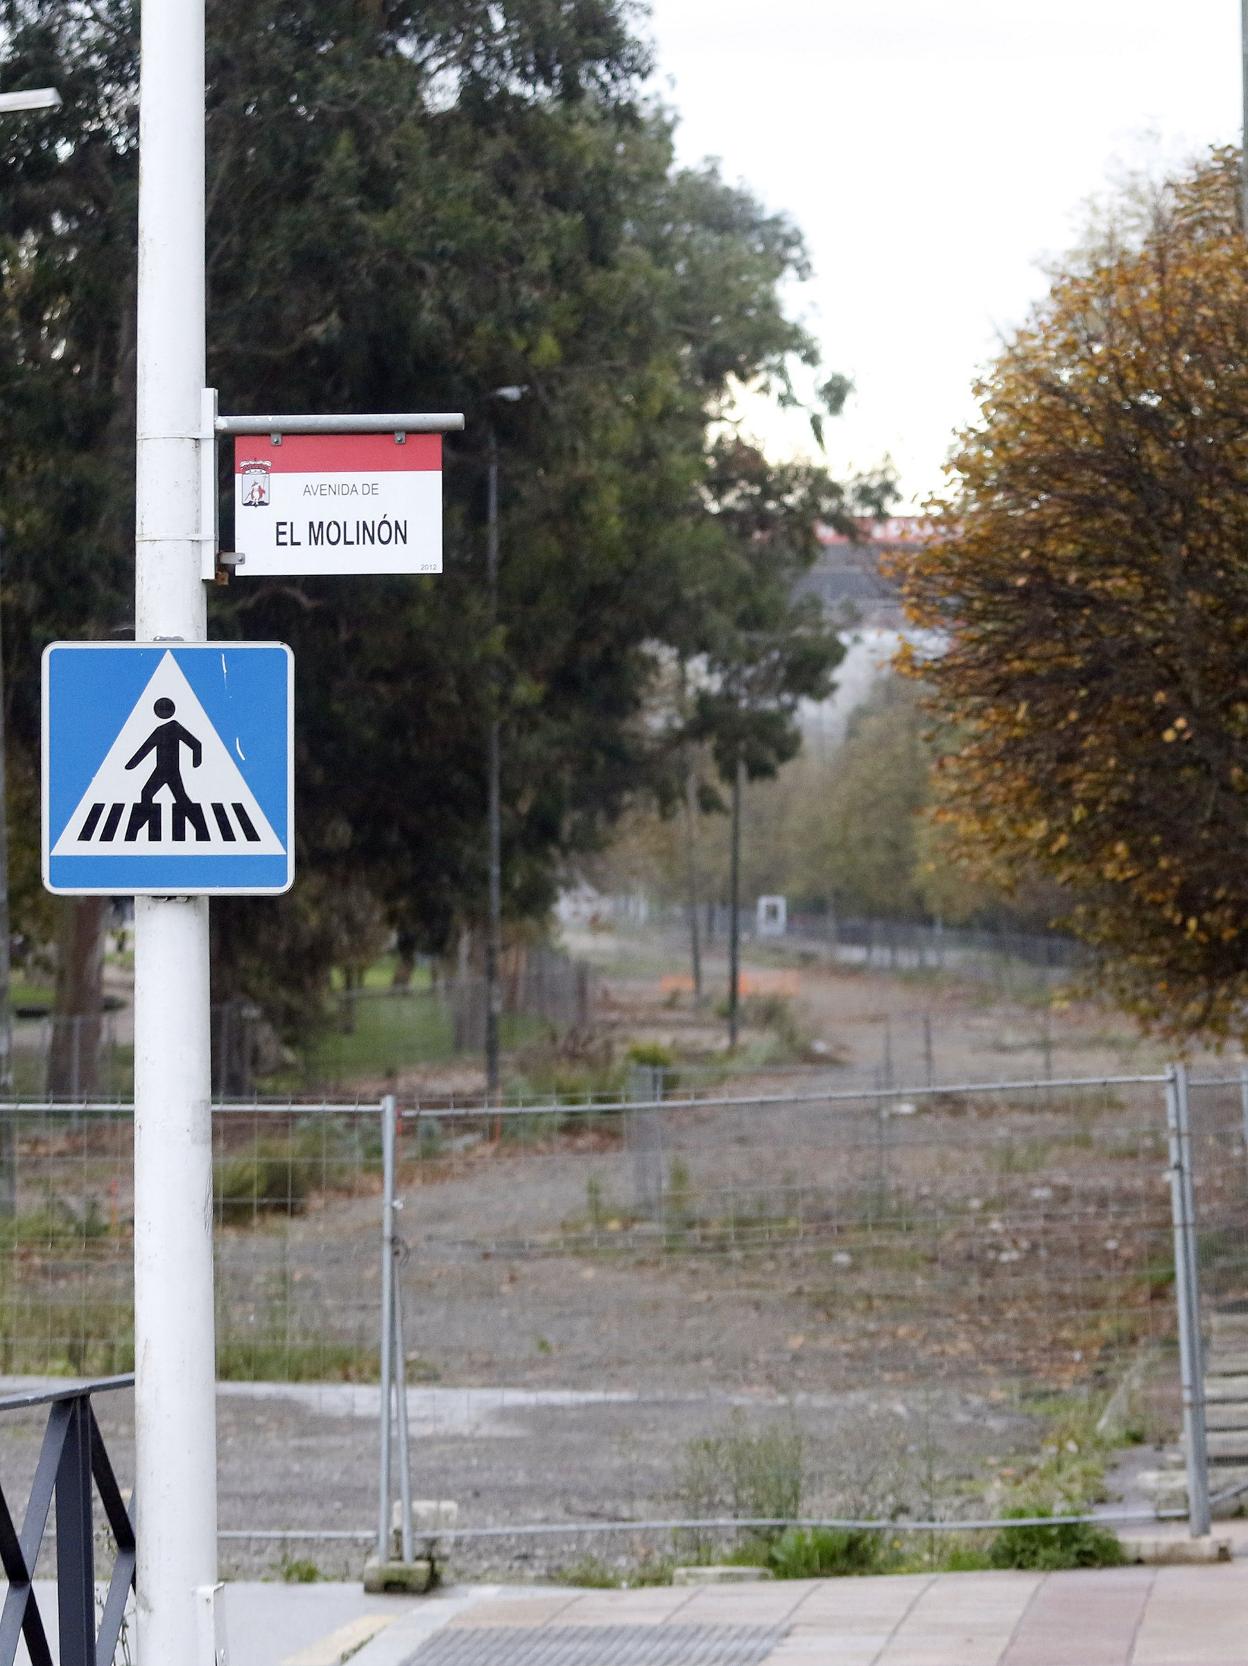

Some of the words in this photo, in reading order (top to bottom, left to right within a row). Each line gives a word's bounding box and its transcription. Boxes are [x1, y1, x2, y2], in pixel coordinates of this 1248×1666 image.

[302, 482, 359, 497] AVENIDA
[361, 482, 379, 496] DE
[275, 520, 302, 546] EL
[308, 513, 408, 546] MOLINÓN
[420, 563, 437, 571] 2012
